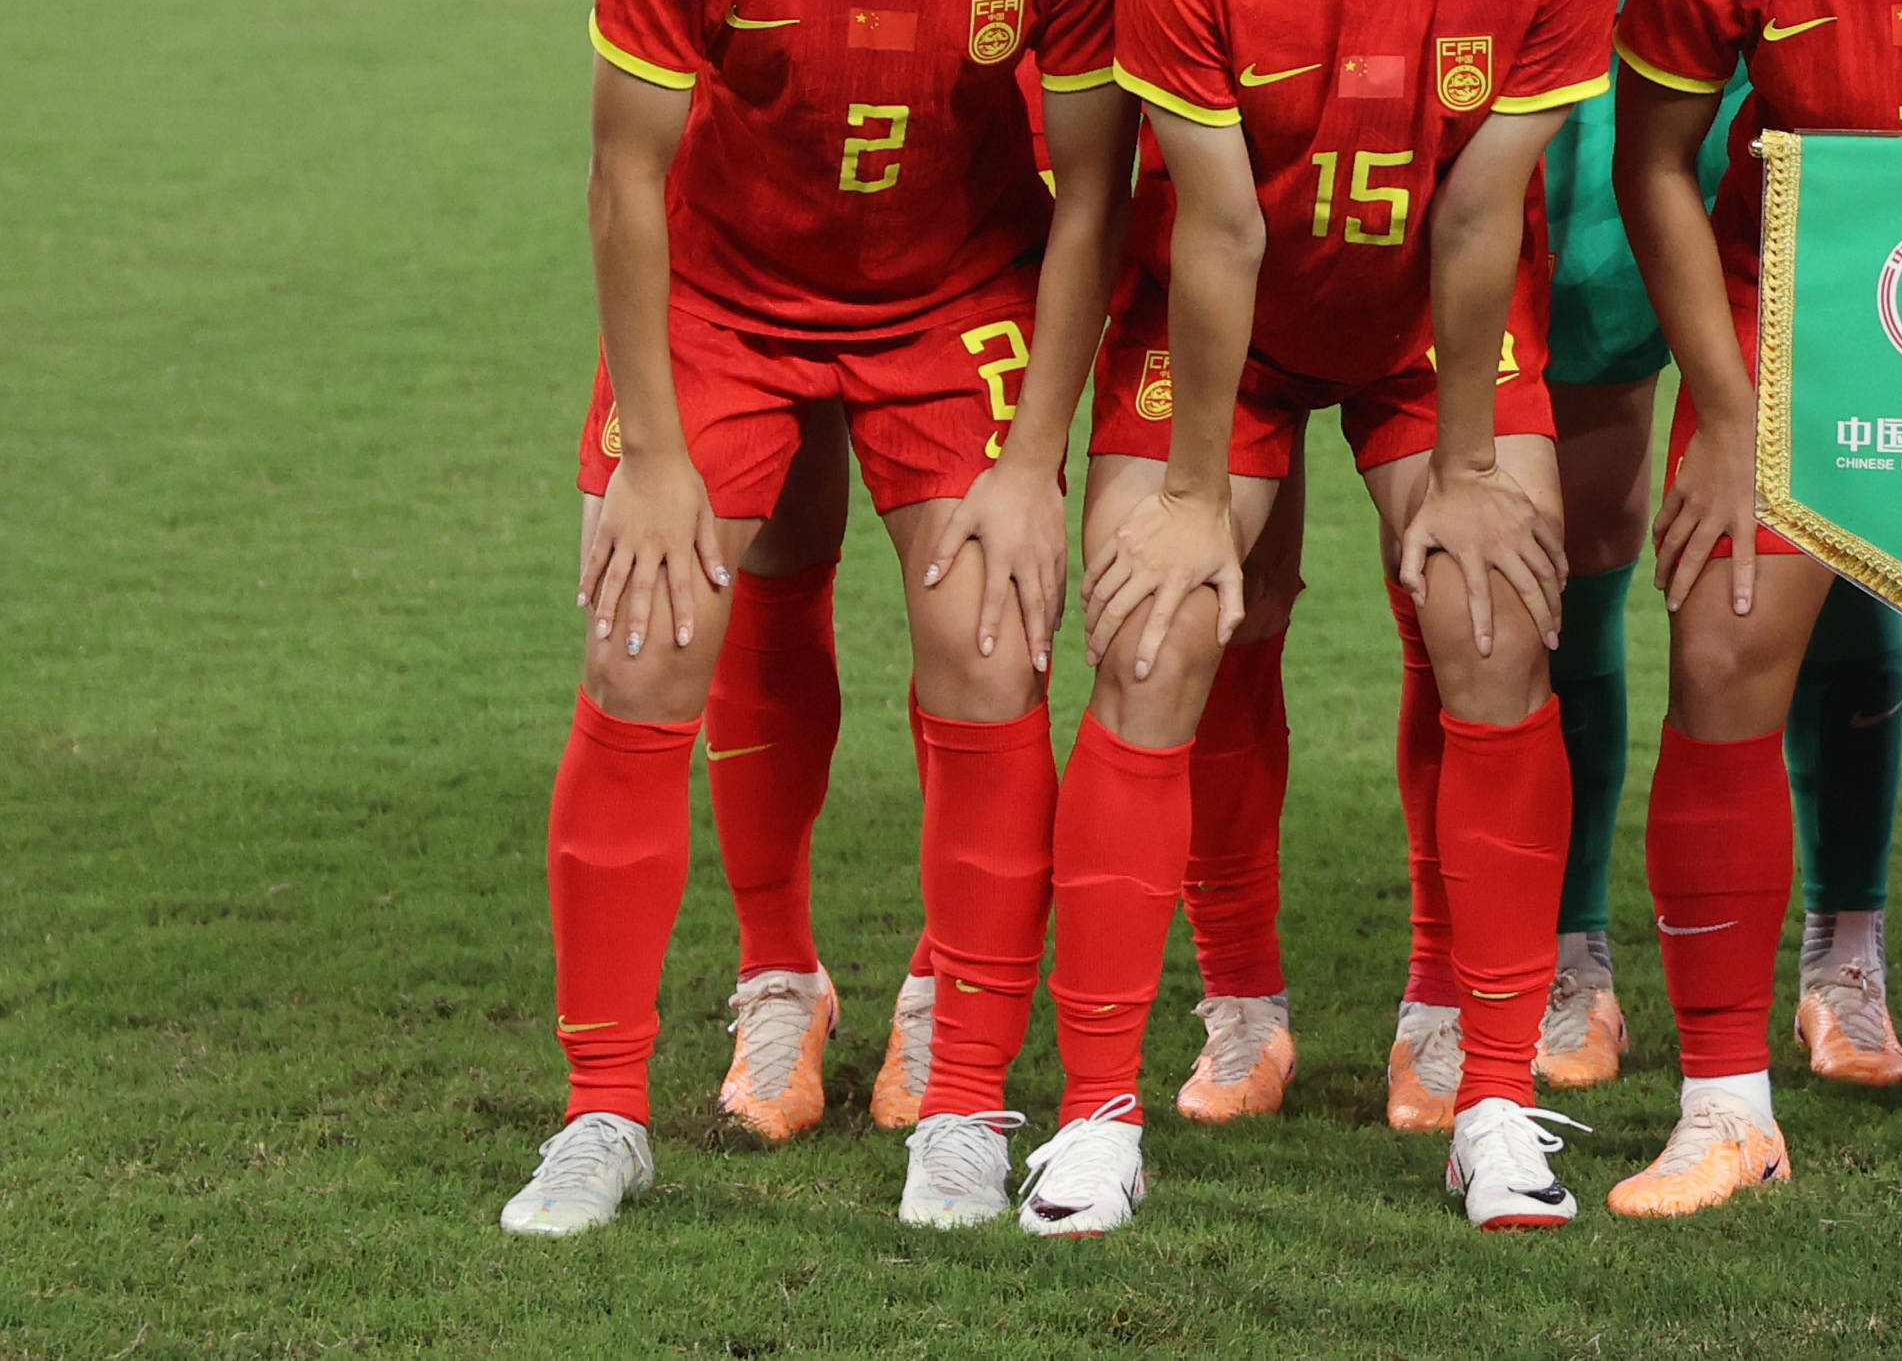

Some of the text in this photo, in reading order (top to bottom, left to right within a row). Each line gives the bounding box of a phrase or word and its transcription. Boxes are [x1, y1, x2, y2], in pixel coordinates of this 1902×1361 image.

[976, 0, 1019, 15] CFA
[1442, 41, 1487, 56] CFA
[839, 103, 910, 193] 2
[1311, 149, 1413, 246] 15
[1836, 457, 1895, 470] CHINESE
